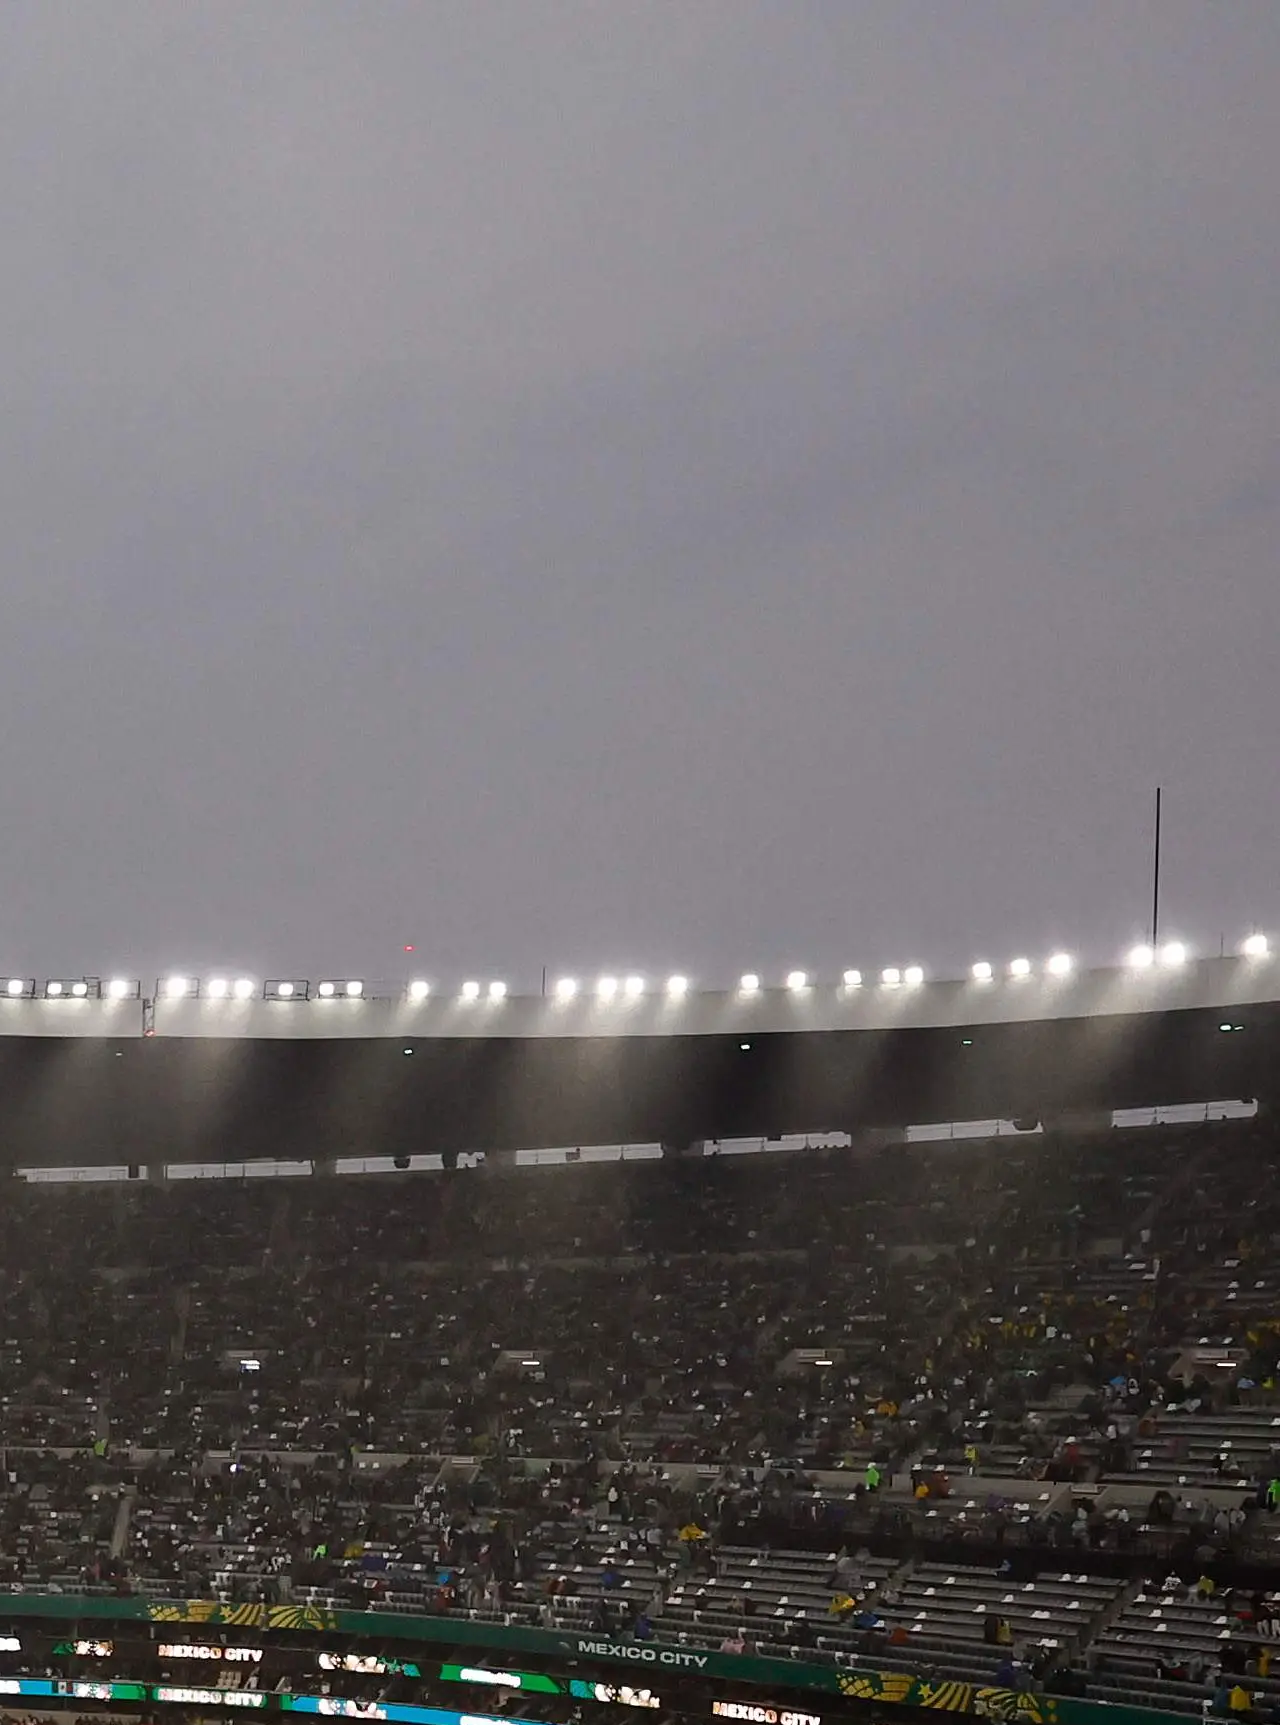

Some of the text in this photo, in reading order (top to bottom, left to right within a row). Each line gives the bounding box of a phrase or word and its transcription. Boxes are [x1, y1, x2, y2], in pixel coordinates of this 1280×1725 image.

[158, 1645, 263, 1662] MEXICO CITY
[578, 1641, 708, 1667] MEXICO CITY
[158, 1688, 264, 1707] MEXICO CITY
[712, 1701, 777, 1724] MEXICO
